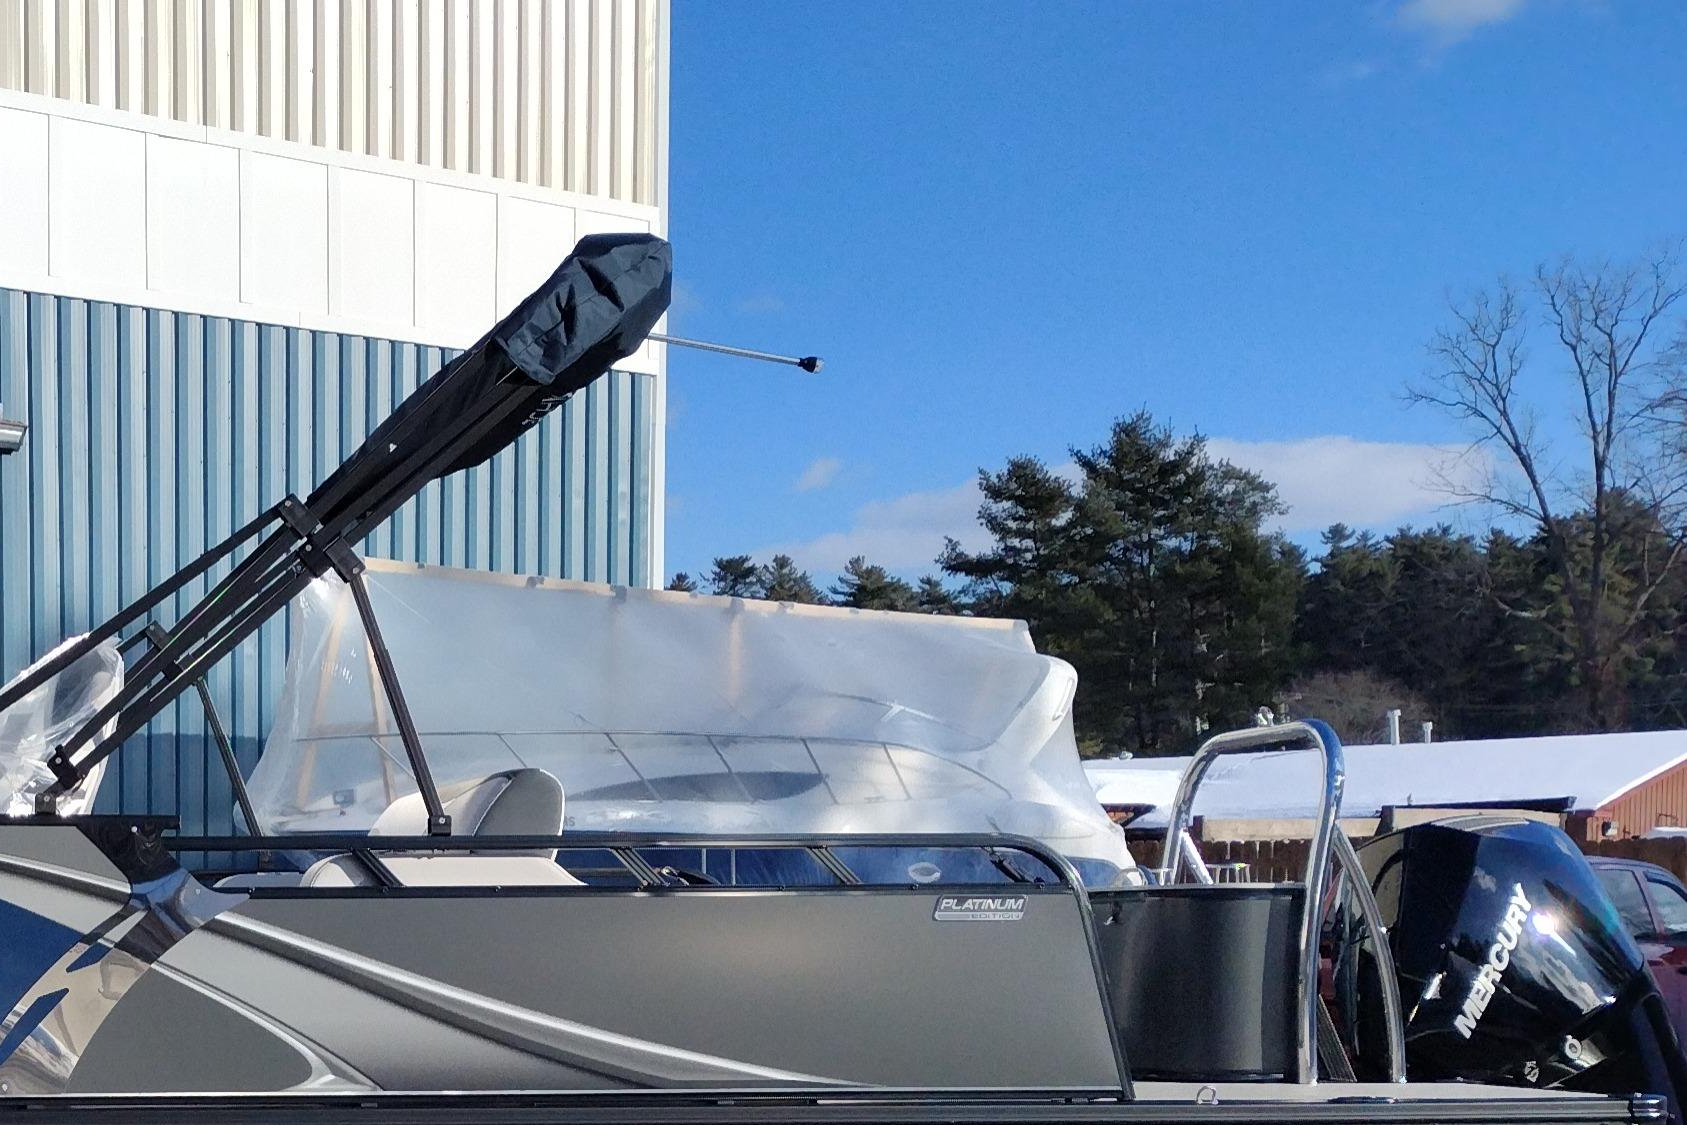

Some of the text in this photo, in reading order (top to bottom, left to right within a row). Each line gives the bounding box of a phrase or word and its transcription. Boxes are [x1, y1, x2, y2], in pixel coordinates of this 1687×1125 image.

[940, 898, 1024, 910] PLATINUM
[970, 912, 1021, 920] EDITION
[1454, 882, 1531, 1039] MERCURY
